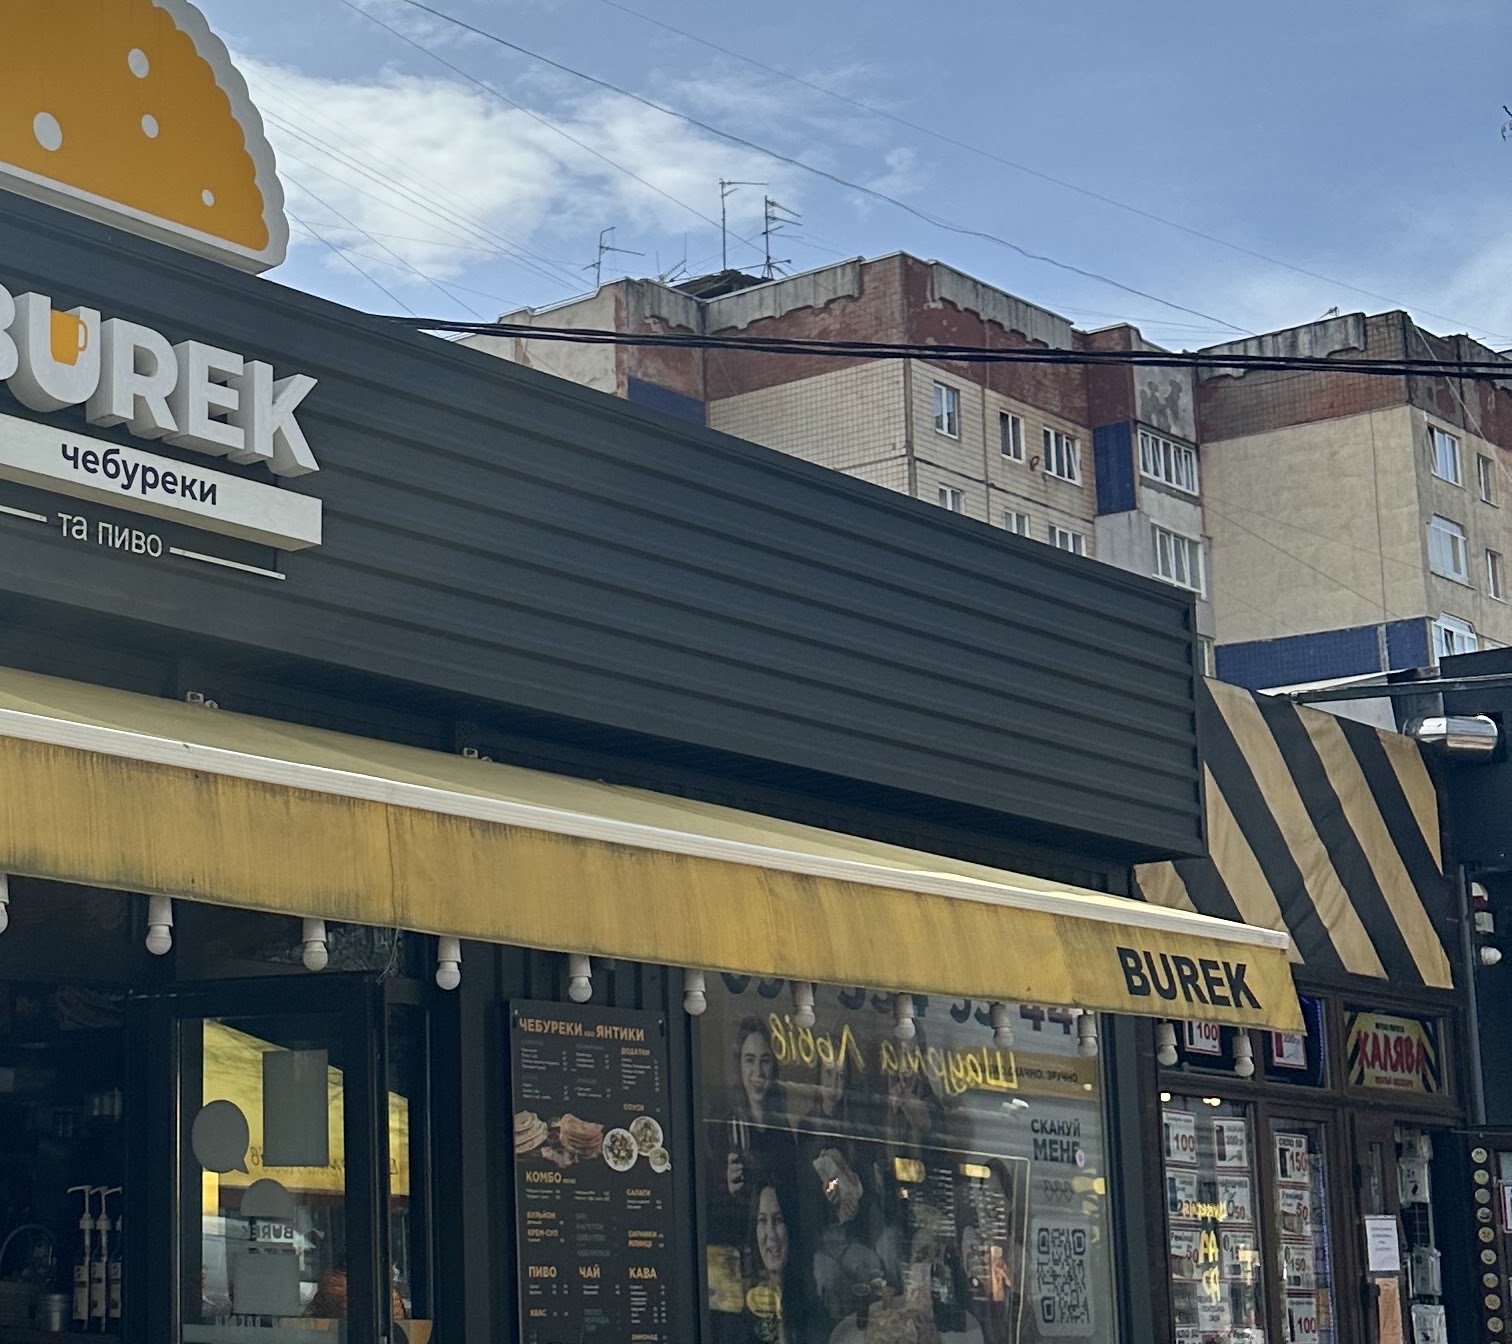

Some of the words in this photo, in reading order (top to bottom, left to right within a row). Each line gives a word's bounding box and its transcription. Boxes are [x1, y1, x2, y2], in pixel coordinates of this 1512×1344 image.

[60, 442, 218, 507] чебуреки
[57, 512, 88, 542] та
[98, 522, 163, 558] пиво
[1116, 945, 1262, 1010] BUREK
[519, 1017, 583, 1037] ЧЕБУРЕКИ
[596, 1024, 645, 1041] ЯНТИКИ
[1357, 1030, 1428, 1076] ХАЛЯВА
[1030, 1118, 1081, 1138] СКАНУЙ
[525, 1171, 562, 1184] КОМБО
[528, 1265, 557, 1279] ПИВО
[579, 1264, 601, 1279] ЧАЙ
[628, 1266, 657, 1279] КАВА
[1297, 1316, 1317, 1334] 100
